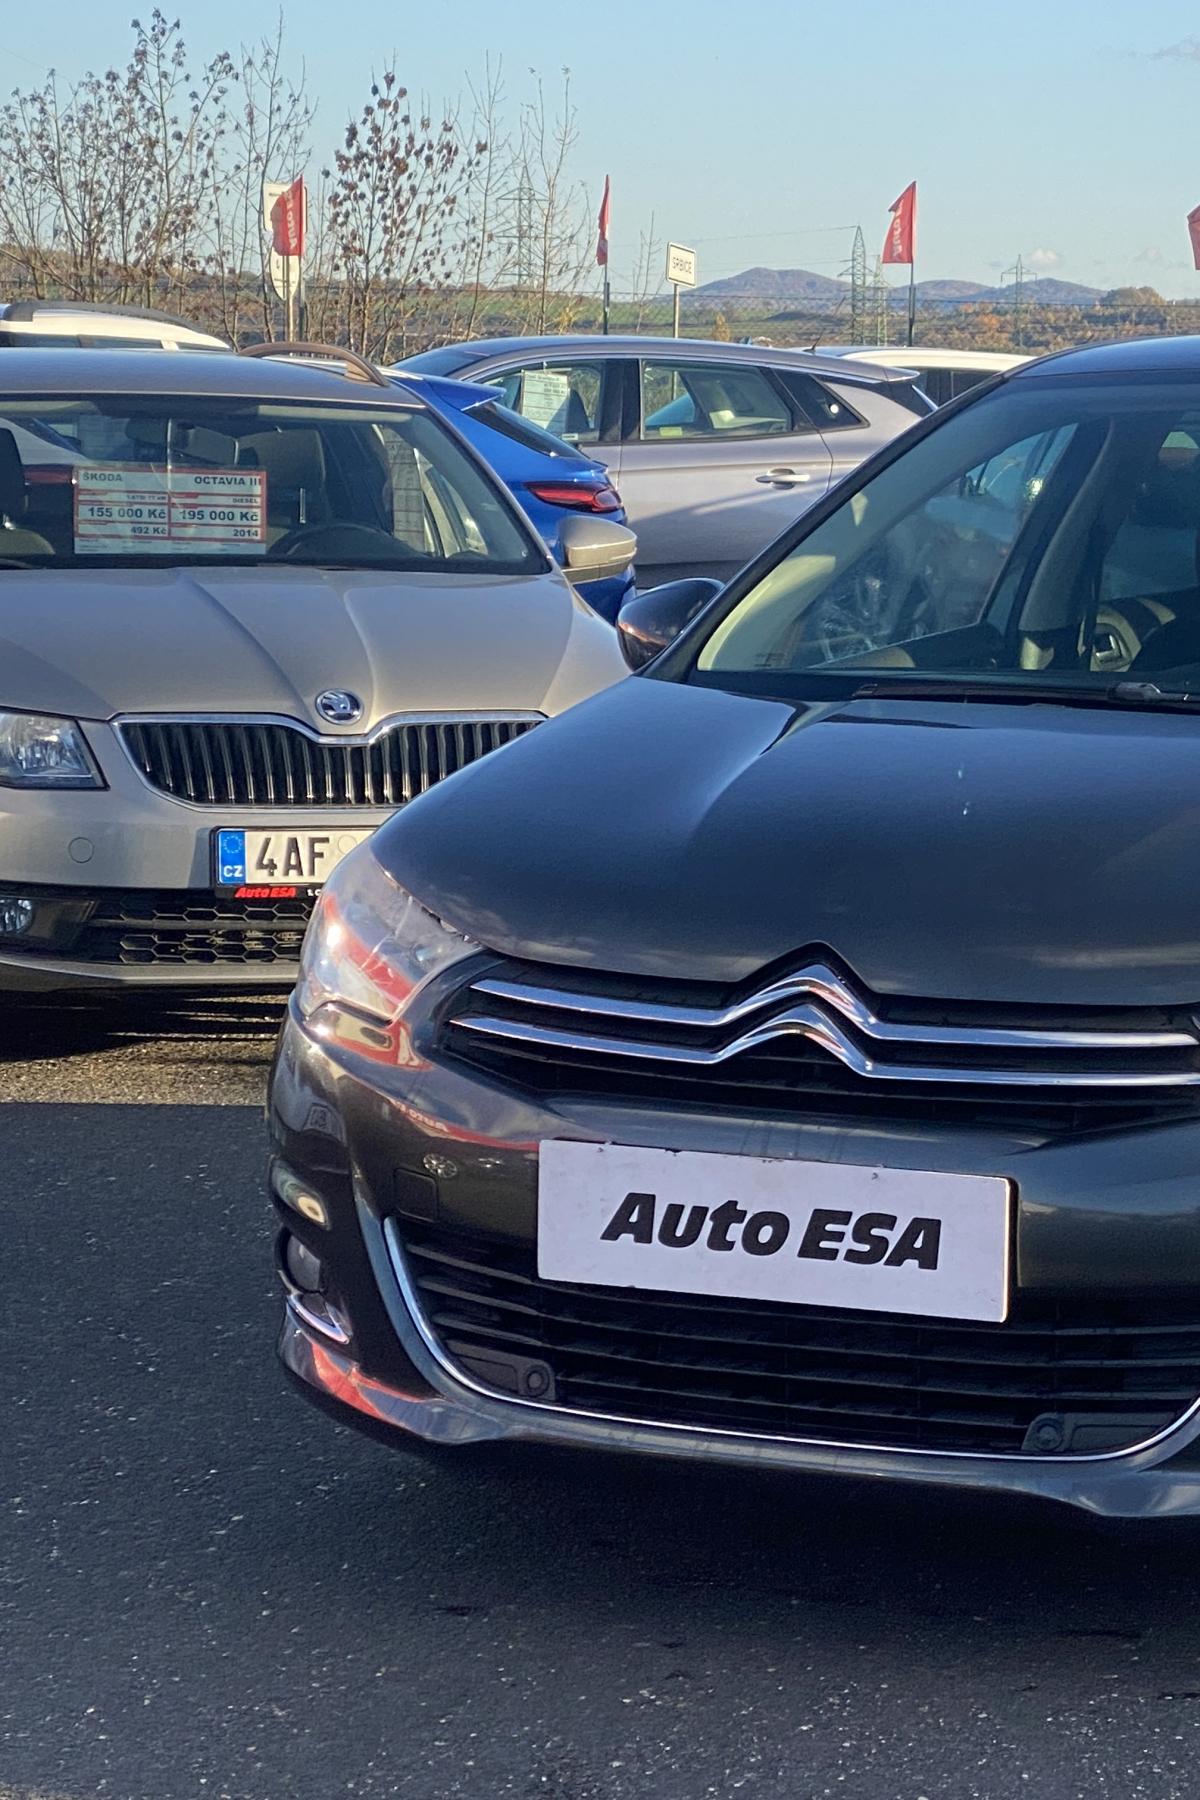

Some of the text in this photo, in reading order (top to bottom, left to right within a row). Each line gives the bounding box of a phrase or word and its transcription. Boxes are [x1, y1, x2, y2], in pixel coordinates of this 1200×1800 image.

[82, 471, 123, 482] ŠKODA
[194, 475, 245, 486] OCTAVIA
[88, 507, 167, 519] 155 000 Kč
[179, 509, 259, 522] 195 000 Kč
[131, 526, 167, 535] 492 Kč
[233, 529, 259, 537] 2014
[255, 836, 330, 877] 4AF
[223, 865, 243, 877] CZ
[235, 887, 270, 898] Auto
[270, 887, 297, 898] ESA
[600, 1192, 942, 1271] Auto ESA
